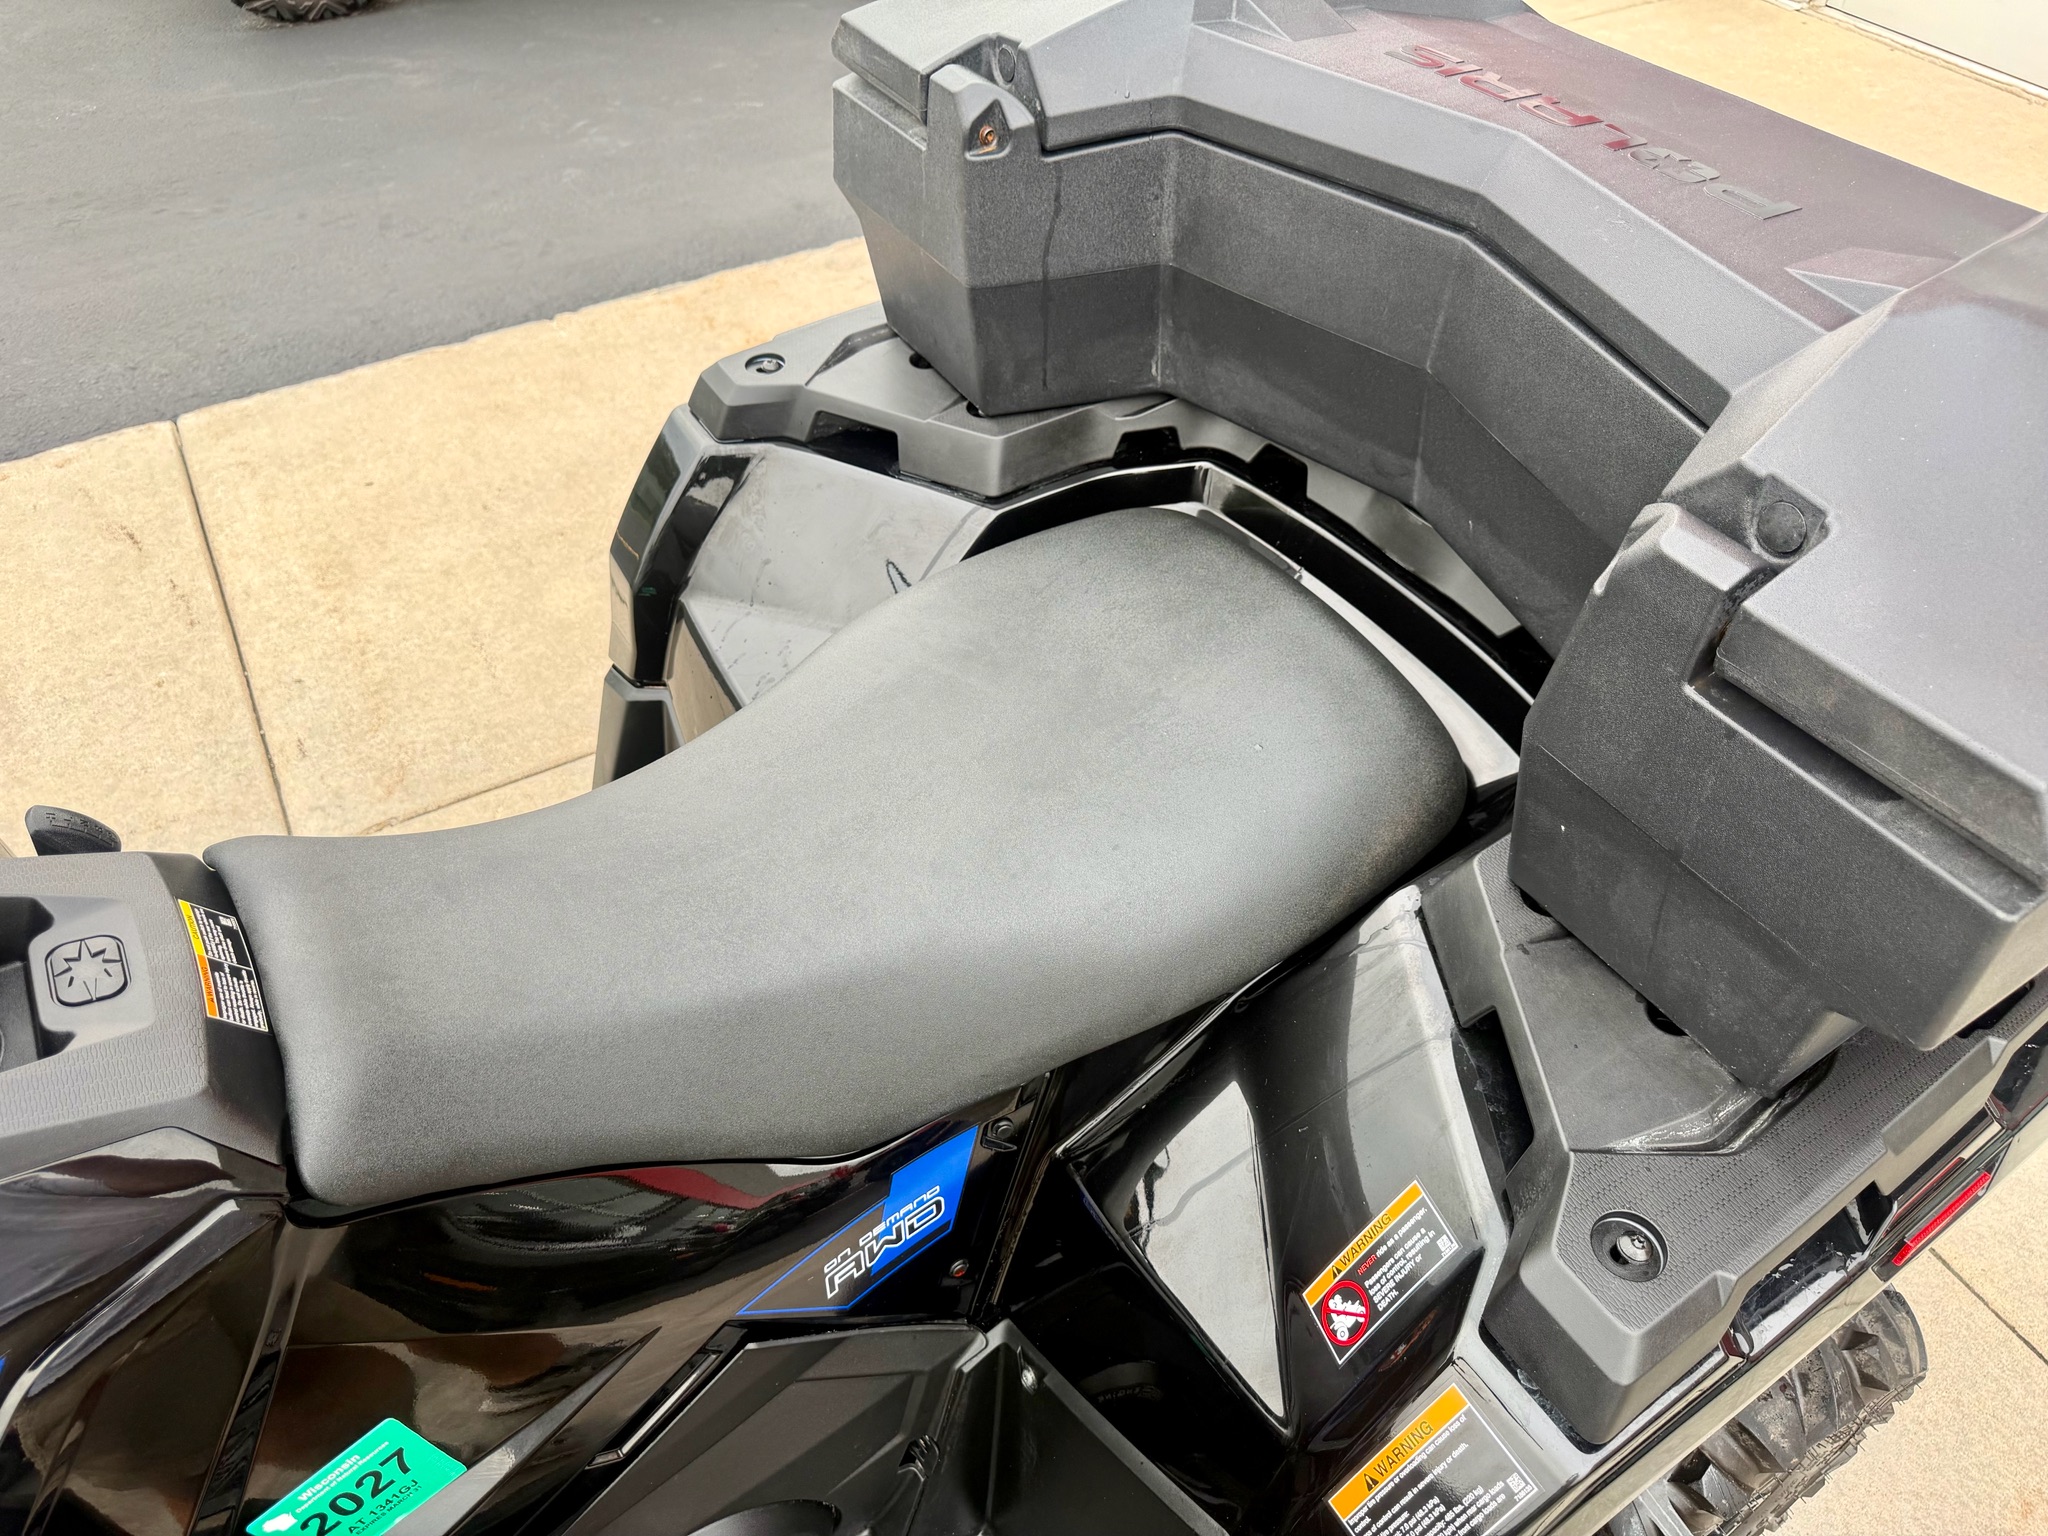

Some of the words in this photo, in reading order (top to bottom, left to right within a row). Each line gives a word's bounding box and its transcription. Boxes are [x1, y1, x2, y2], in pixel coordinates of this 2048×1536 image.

[1384, 44, 1802, 220] POLARIS
[201, 966, 215, 999] WARNING
[859, 1185, 940, 1247] DEMAND
[1339, 1213, 1392, 1266] WARNING
[825, 1197, 945, 1299] AWD
[1357, 1254, 1377, 1275] NEVER
[1376, 1245, 1388, 1257] ride
[1386, 1238, 1395, 1247] as
[1364, 1257, 1395, 1288] Passengers
[1394, 1247, 1405, 1260] can
[1404, 1232, 1421, 1250] cause
[1368, 1283, 1381, 1296] loss
[1380, 1275, 1387, 1285] of
[1405, 1235, 1430, 1260] resulting
[1427, 1230, 1435, 1238] in
[1373, 1279, 1396, 1303] SEVERE
[1394, 1258, 1415, 1282] INJURY
[1415, 1253, 1422, 1263] or
[1377, 1289, 1399, 1311] DEATH.
[1348, 1505, 1368, 1526] Improper
[1366, 1498, 1376, 1508] tire
[1374, 1481, 1395, 1502] pressure
[1393, 1475, 1400, 1483] or
[1399, 1450, 1428, 1478] overloading
[1425, 1443, 1436, 1454] can
[1434, 1430, 1450, 1446] cause
[1447, 1420, 1461, 1433] loss
[1459, 1413, 1467, 1423] of
[1373, 1420, 1434, 1477] WARNING
[295, 1486, 331, 1513] Department
[336, 1464, 359, 1482] Natural
[357, 1441, 389, 1465] Resources
[297, 1455, 360, 1501] Wisconsin
[300, 1446, 412, 1536] 2027
[1376, 1510, 1393, 1528] control
[1391, 1503, 1401, 1514] can
[1399, 1491, 1414, 1506] result
[1417, 1471, 1435, 1490] severe
[1432, 1461, 1447, 1476] injury
[1446, 1455, 1453, 1463] or
[1452, 1443, 1469, 1458] death.
[1472, 1485, 1484, 1496] kg)
[348, 1517, 366, 1534] AT
[369, 1479, 418, 1515] 1341GJ
[355, 1510, 386, 1535] EXPIRES
[385, 1491, 413, 1512] MARCH
[1354, 1516, 1371, 1533] control.
[1408, 1516, 1417, 1528] psi
[1426, 1496, 1440, 1509] kPa)
[1414, 1523, 1423, 1535] psi
[1432, 1503, 1446, 1517] kPa)
[1453, 1513, 1468, 1527] when
[1466, 1504, 1477, 1516] rear
[1476, 1492, 1491, 1507] cargo
[1488, 1481, 1505, 1495] loads
[1469, 1512, 1485, 1527] cargo
[1482, 1500, 1498, 1515] loads
[1496, 1493, 1506, 1503] are
